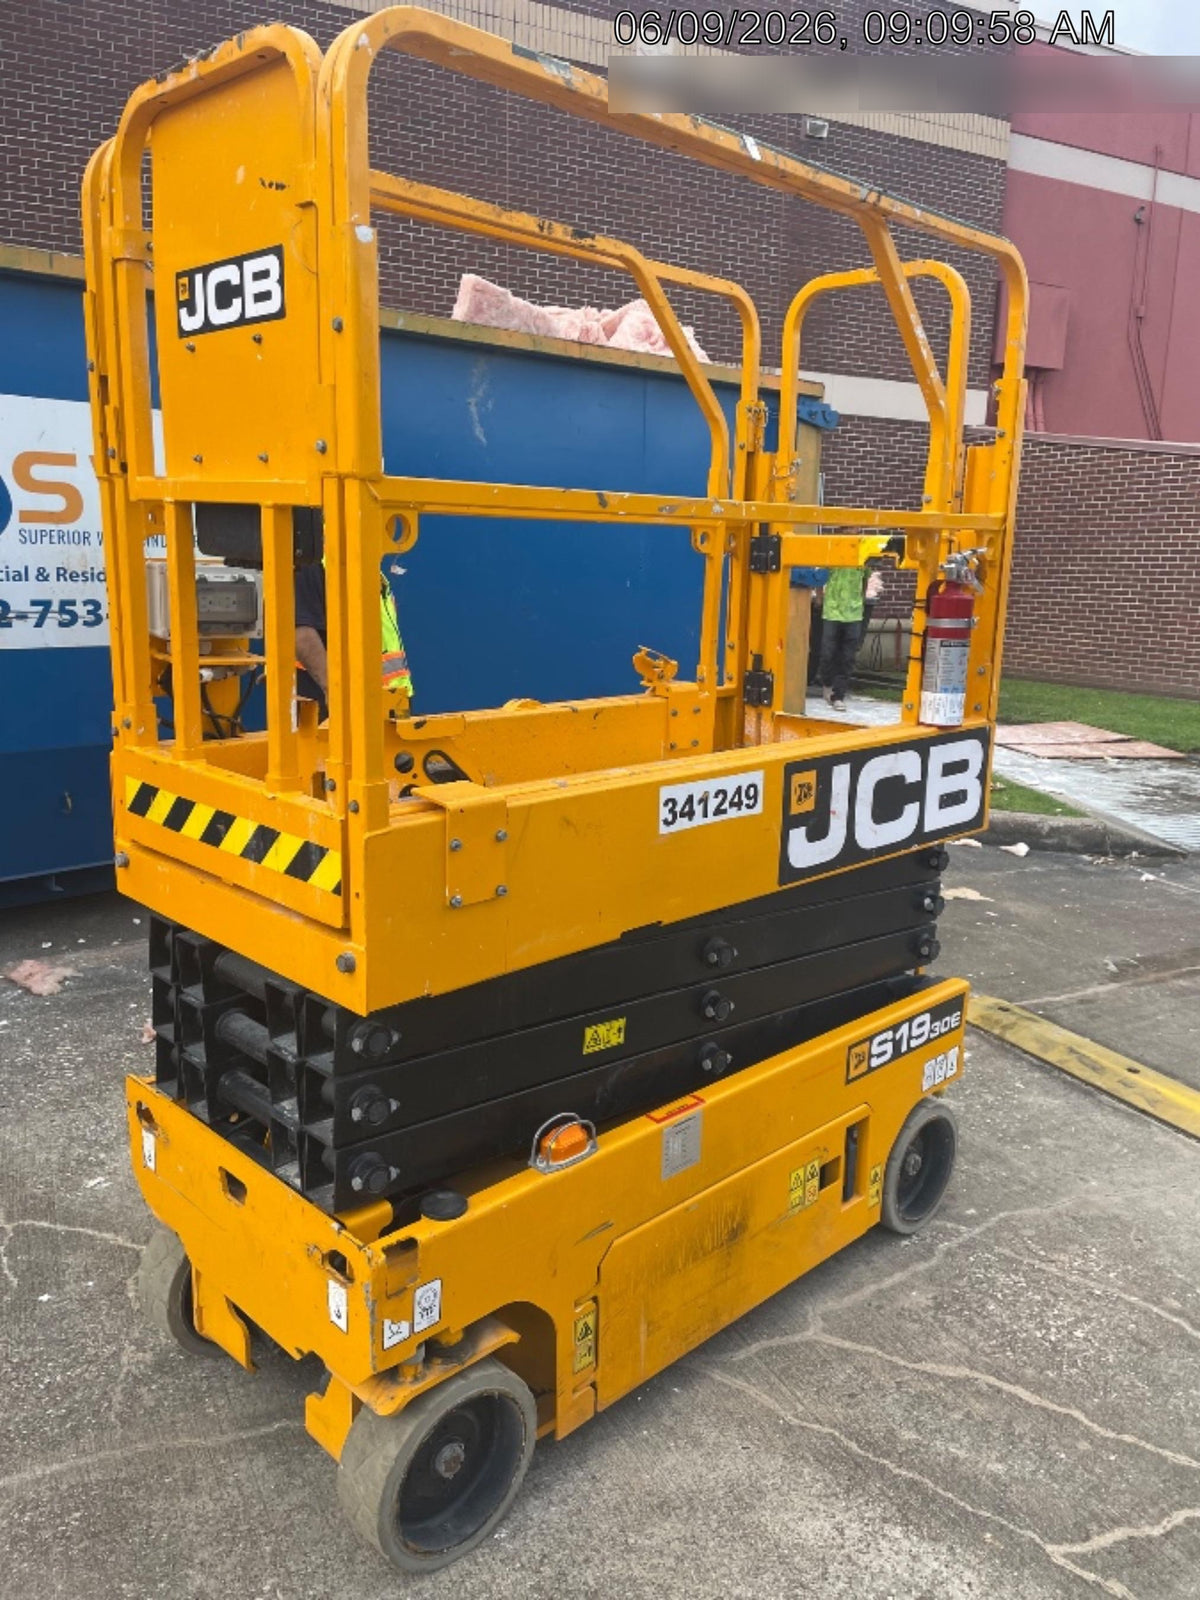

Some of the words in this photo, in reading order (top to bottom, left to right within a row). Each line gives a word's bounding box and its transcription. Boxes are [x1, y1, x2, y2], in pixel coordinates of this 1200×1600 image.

[178, 253, 282, 332] JCB
[12, 451, 98, 526] S
[18, 527, 91, 547] SUPERIOR
[35, 566, 50, 582] &
[0, 599, 109, 628] 2-753
[661, 782, 759, 827] 341249
[786, 738, 985, 869] JCB
